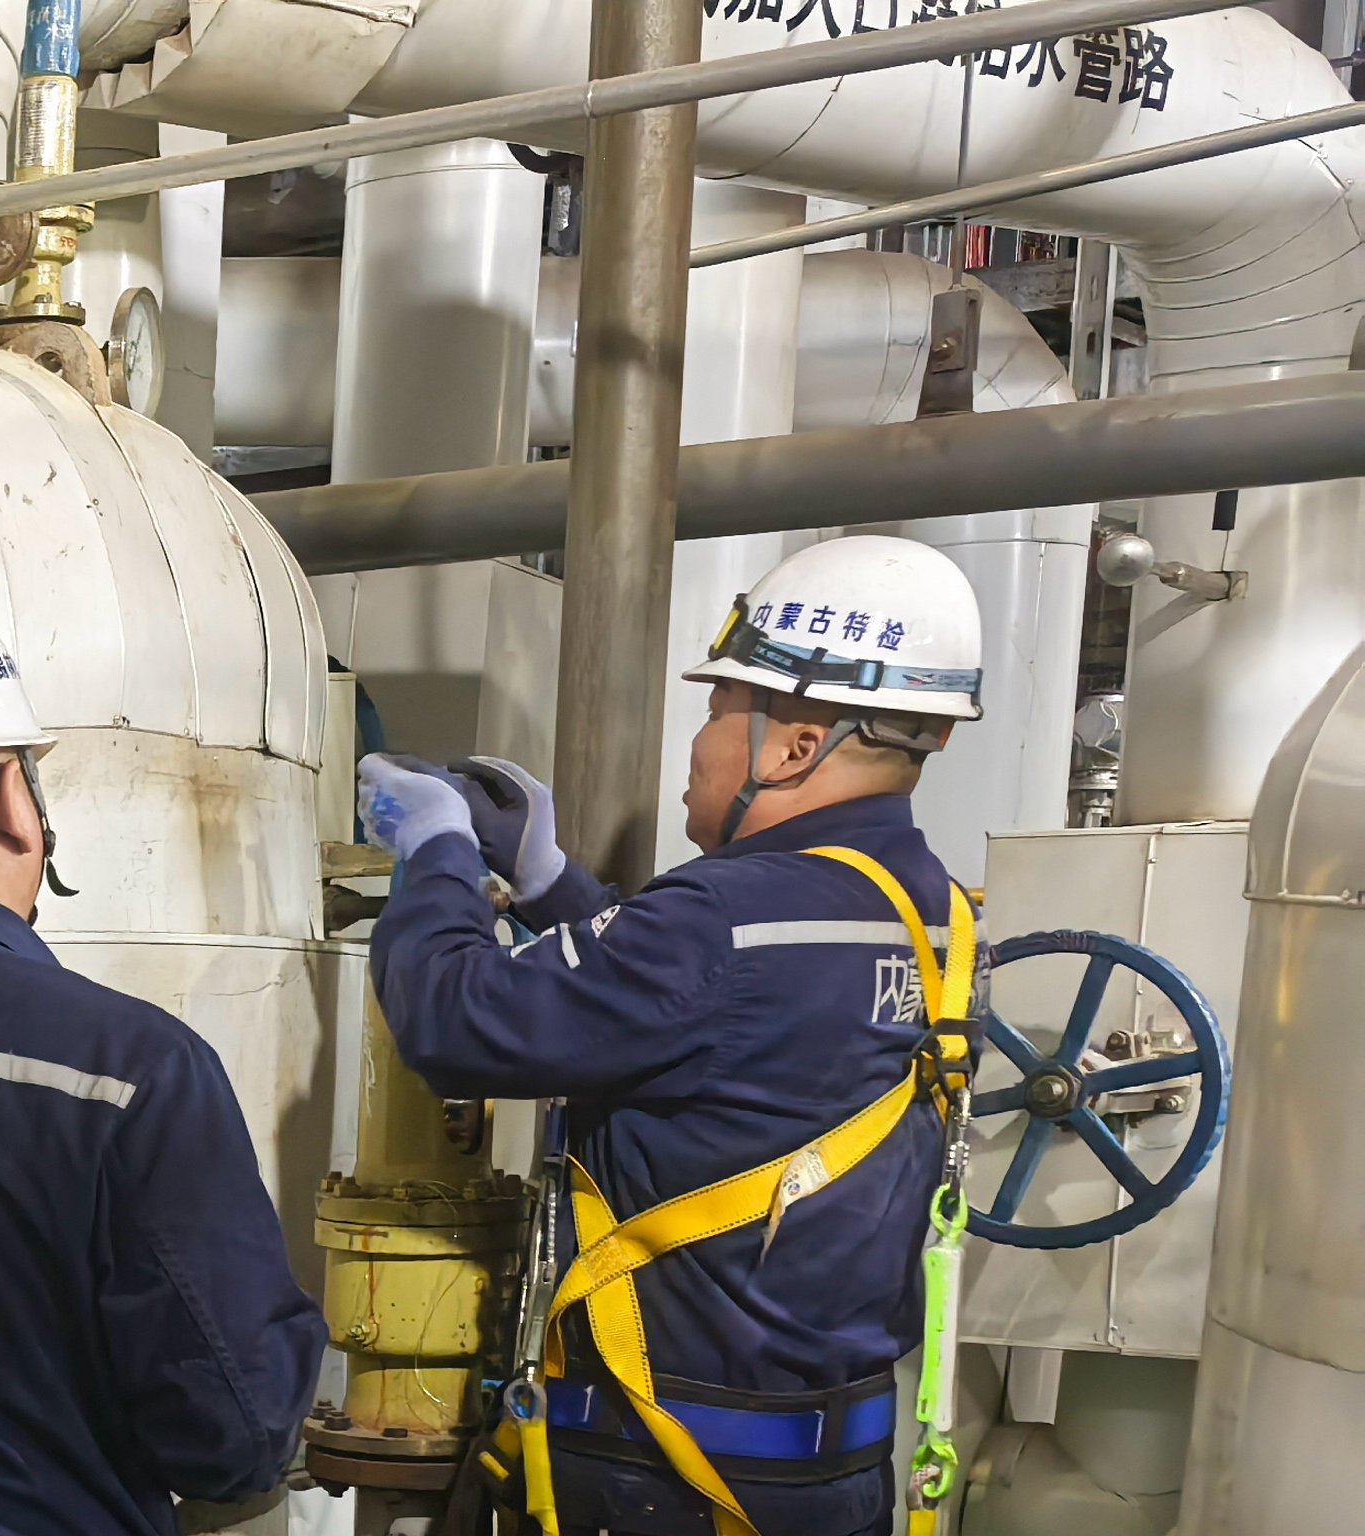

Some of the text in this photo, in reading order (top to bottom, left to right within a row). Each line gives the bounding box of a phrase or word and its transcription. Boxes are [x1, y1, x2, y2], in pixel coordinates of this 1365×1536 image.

[752, 601, 905, 651] 内蒙古特检
